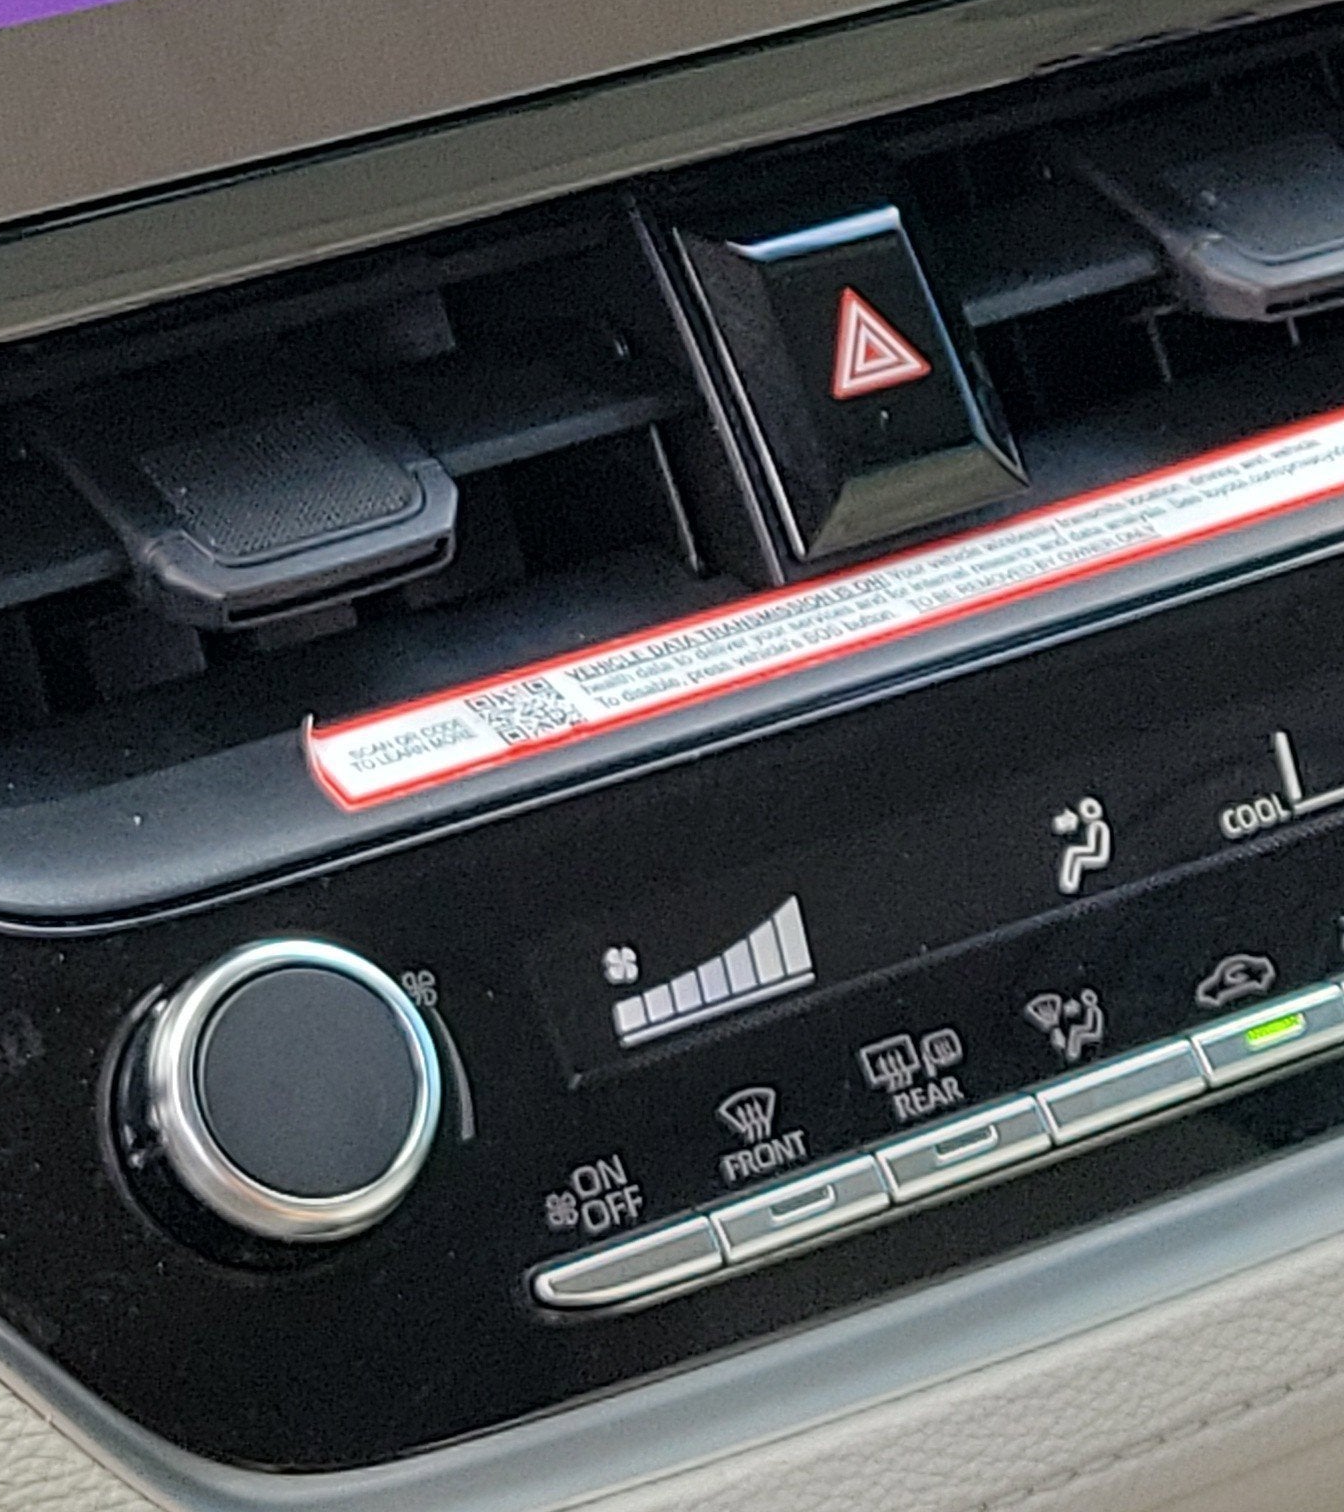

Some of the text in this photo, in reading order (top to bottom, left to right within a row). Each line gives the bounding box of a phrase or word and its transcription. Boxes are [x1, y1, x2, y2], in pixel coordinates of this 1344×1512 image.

[564, 650, 650, 682] VEHICLE
[647, 634, 697, 658] DATA
[1220, 791, 1291, 839] COOL
[892, 1074, 966, 1122] REAR
[570, 1152, 629, 1201] ON
[719, 1128, 808, 1183] FRONT
[581, 1184, 645, 1233] OFF
